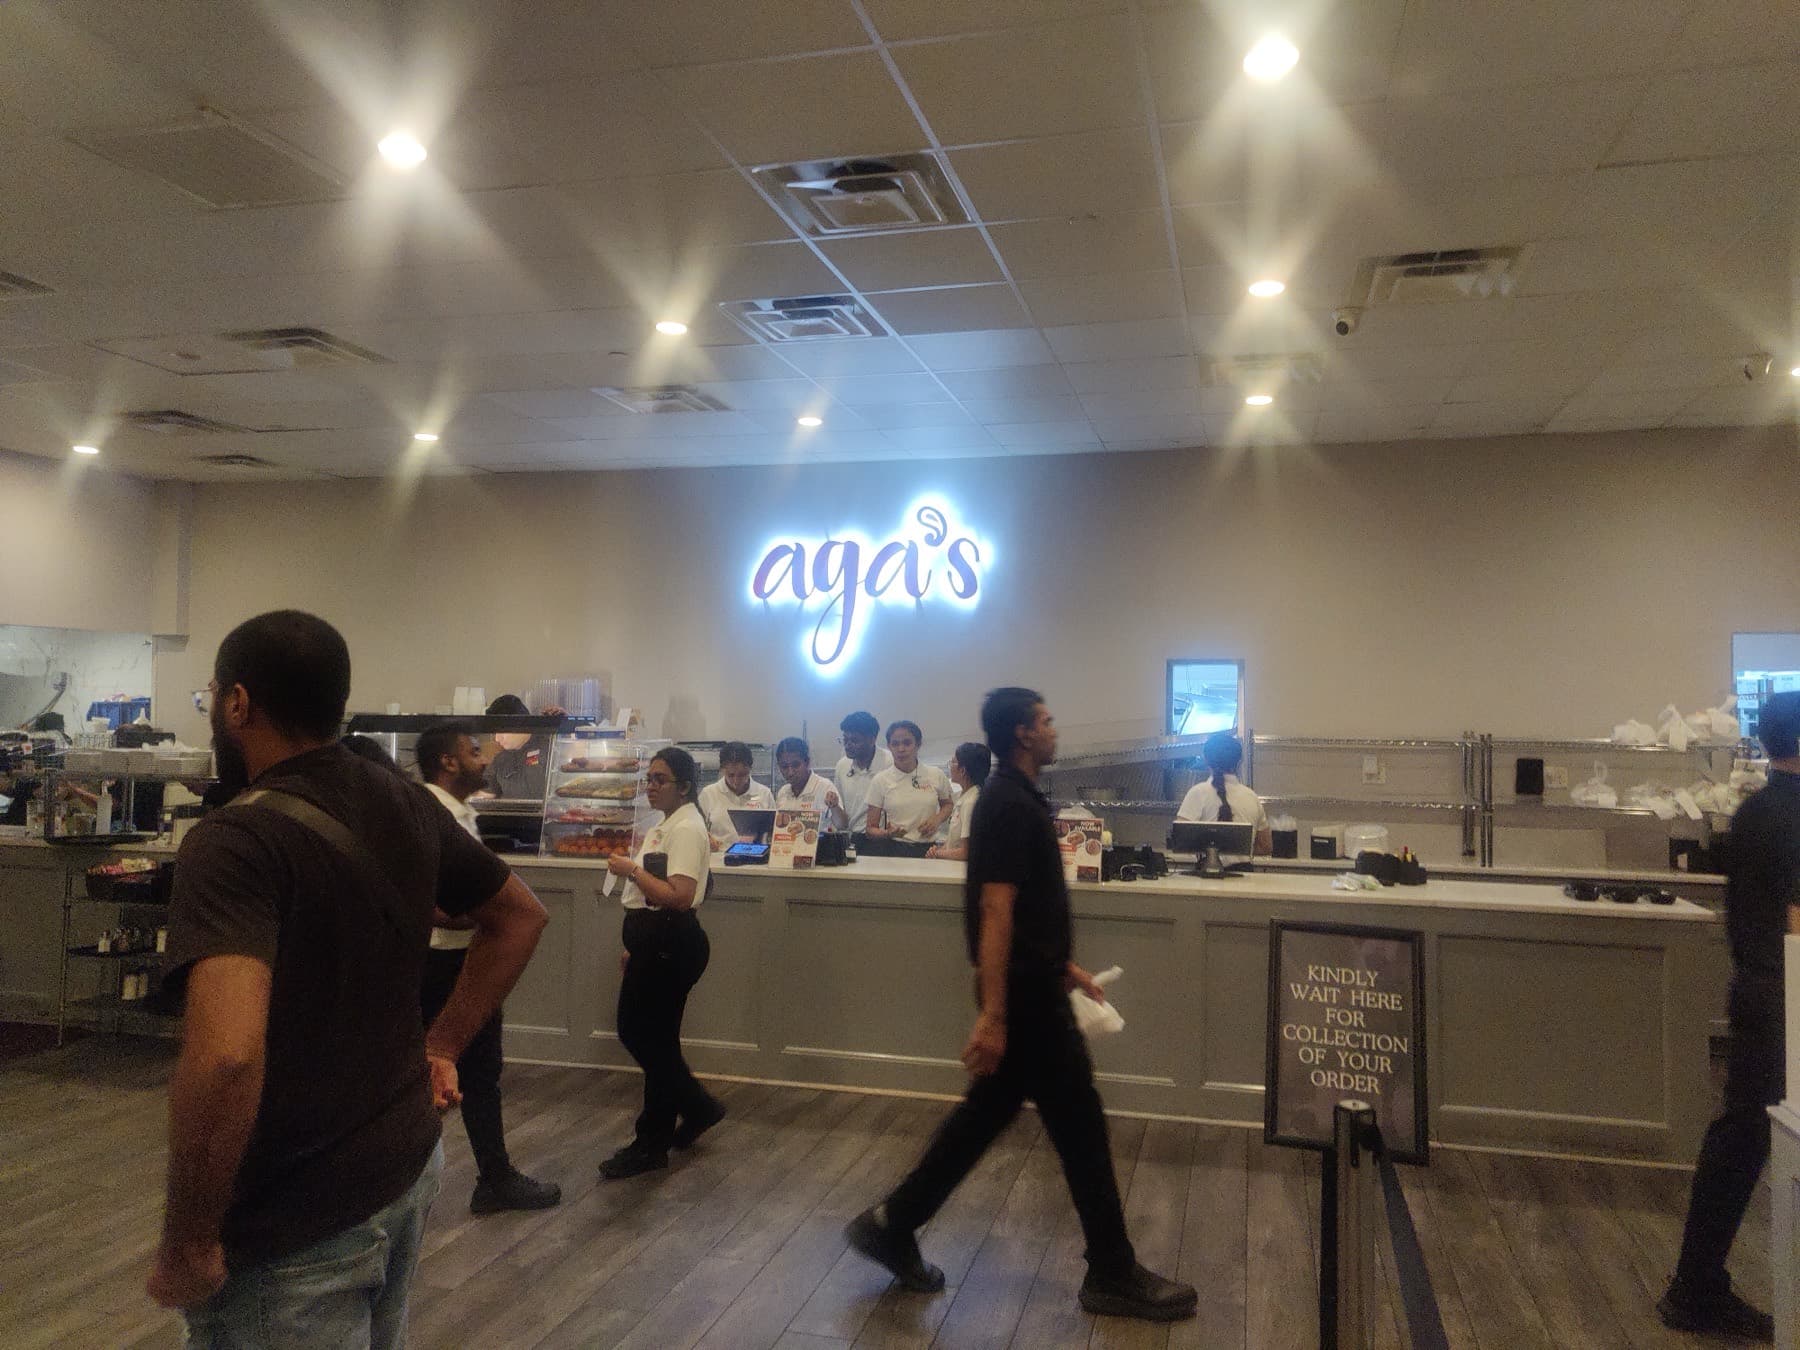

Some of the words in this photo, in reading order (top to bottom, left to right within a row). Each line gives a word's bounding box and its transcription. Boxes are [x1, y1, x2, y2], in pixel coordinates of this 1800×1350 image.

[753, 506, 980, 665] aga's
[1307, 964, 1379, 987] KINDLY
[1290, 983, 1341, 1004] WAIT
[1351, 990, 1403, 1011] HERE
[1325, 1007, 1366, 1028] FOR
[1283, 1023, 1408, 1054] COLLECTION
[1298, 1046, 1327, 1065] OF
[1337, 1050, 1393, 1074] YOUR
[1310, 1069, 1381, 1094] ORDER
